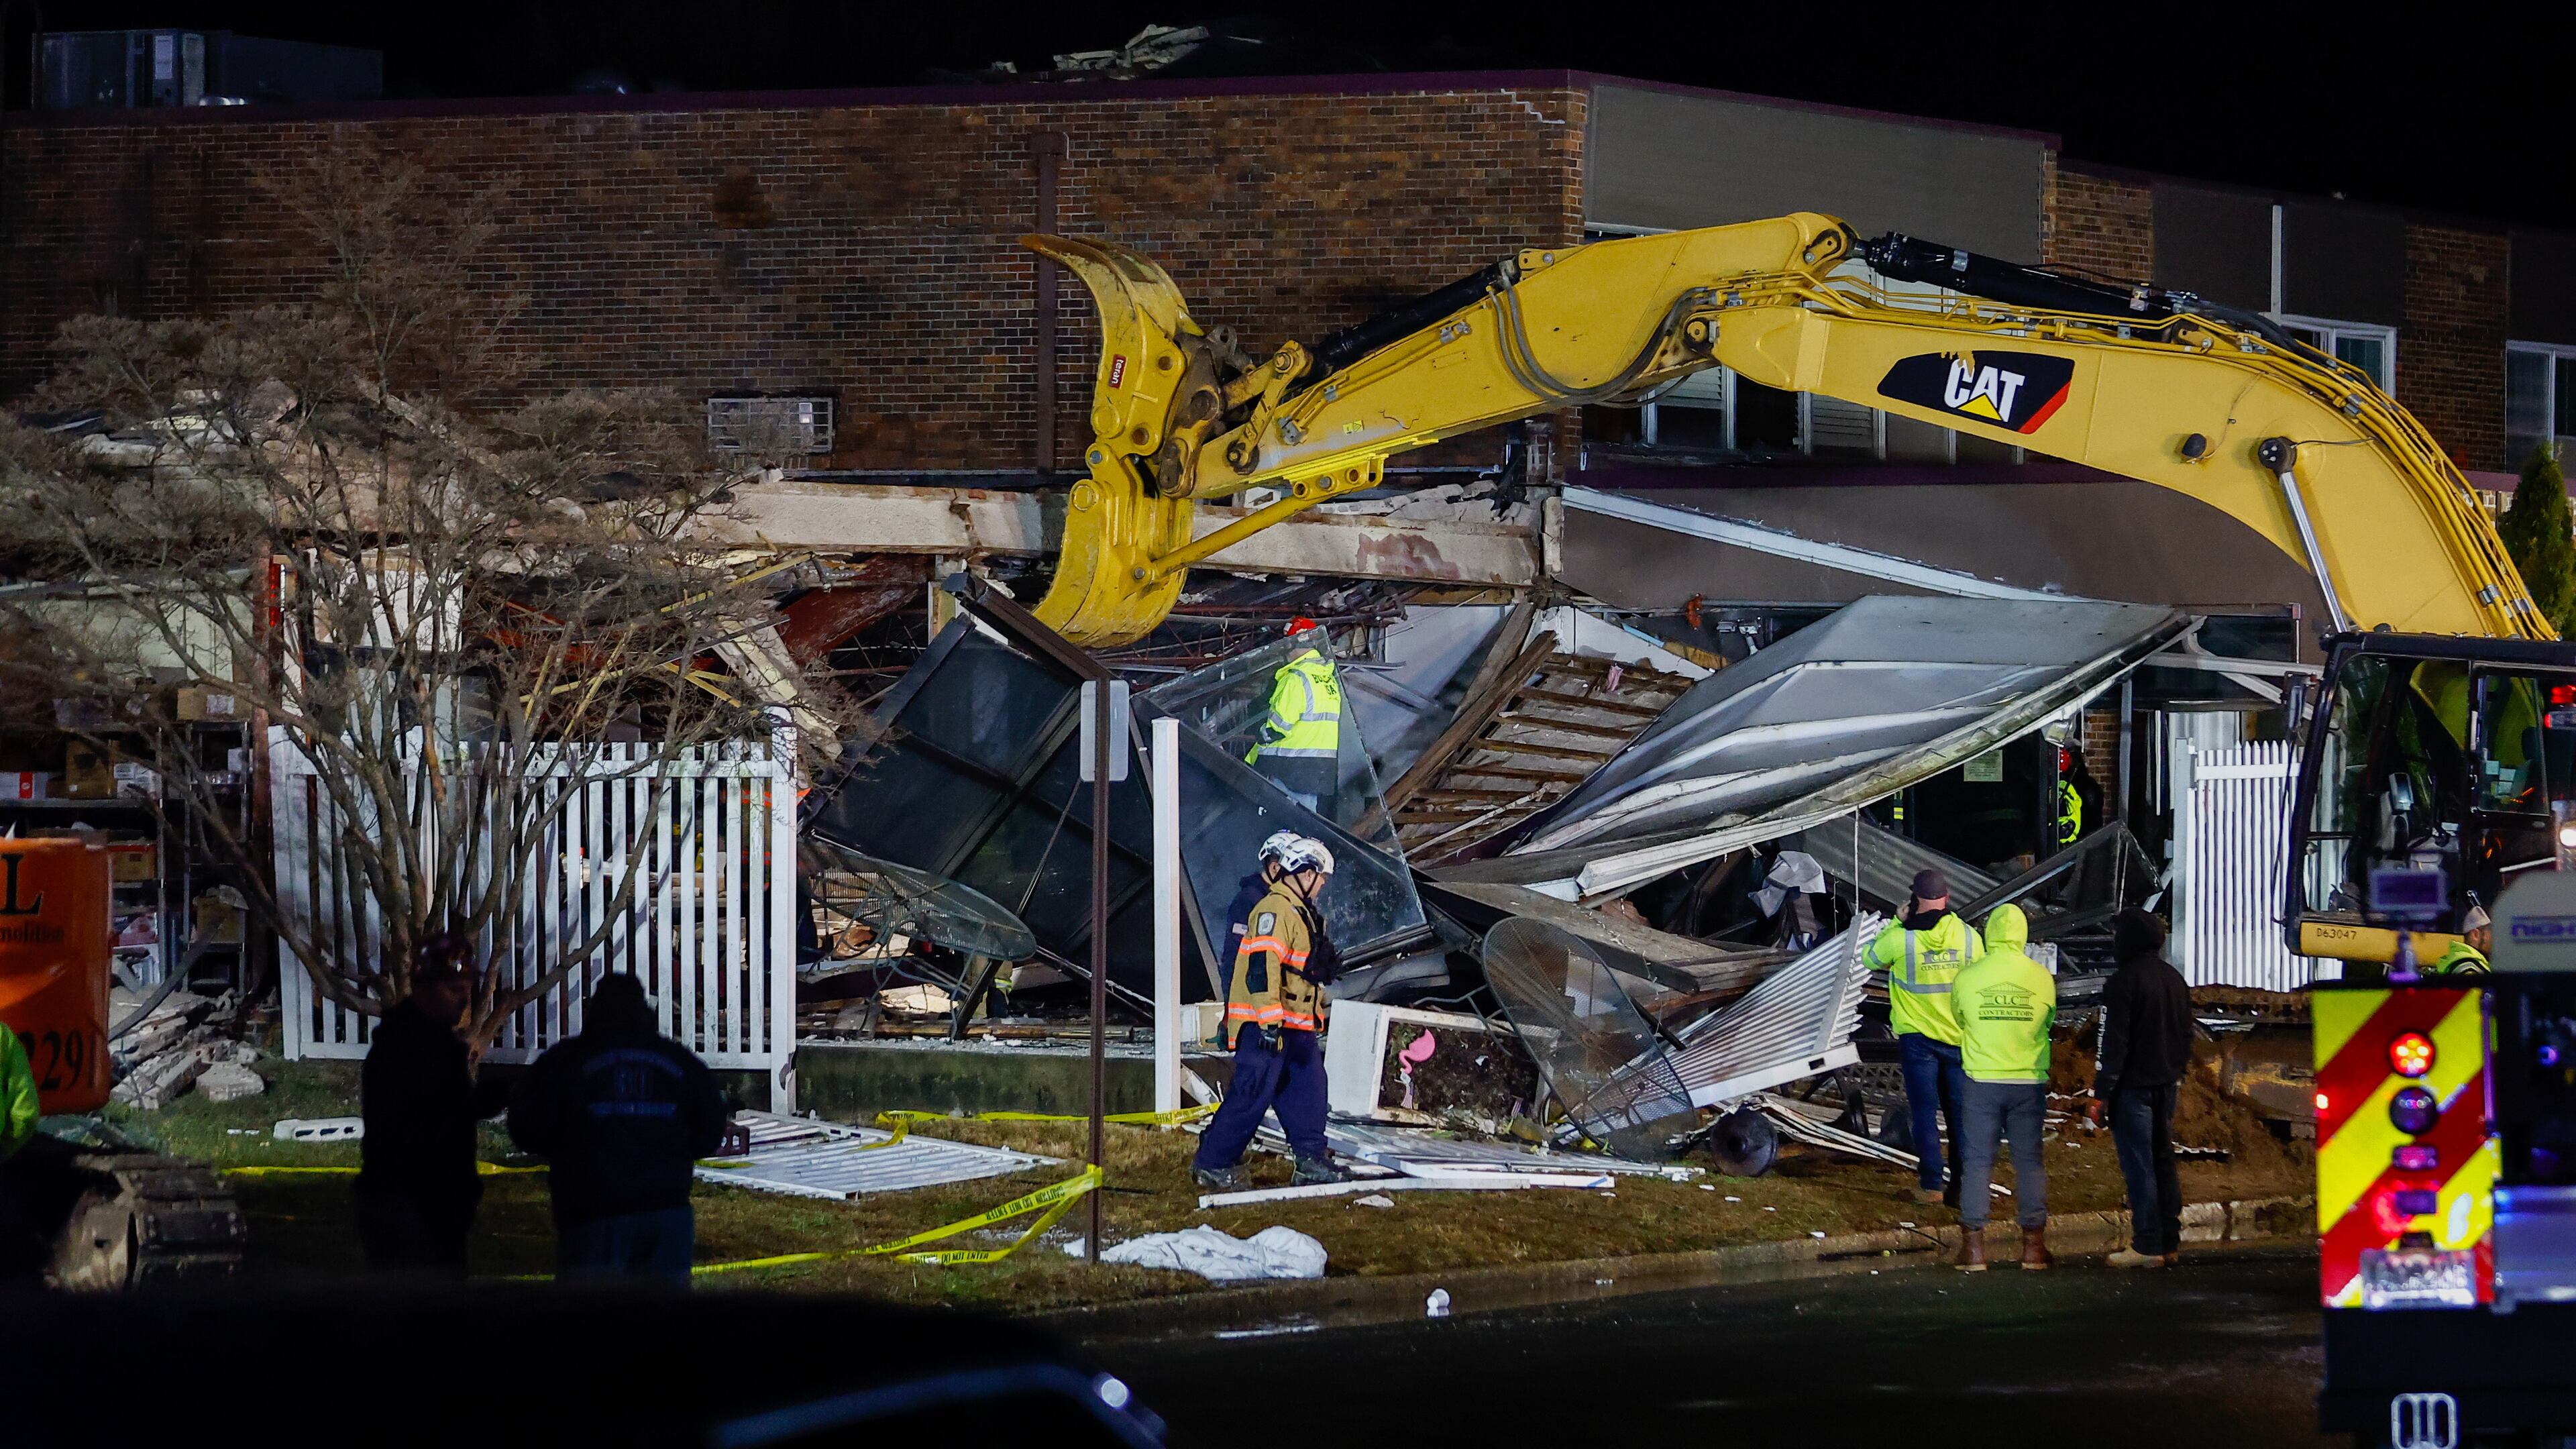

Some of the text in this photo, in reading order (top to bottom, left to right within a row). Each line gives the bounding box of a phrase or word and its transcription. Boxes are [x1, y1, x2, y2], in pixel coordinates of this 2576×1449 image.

[1943, 358, 2025, 423] CAT
[2317, 928, 2357, 940] D63047
[1932, 953, 1949, 961] CLC
[1994, 995, 2019, 1006] CLC
[1978, 1009, 2034, 1017] CONTRACTORS
[941, 1253, 951, 1264] DO
[952, 1252, 964, 1260] NOT
